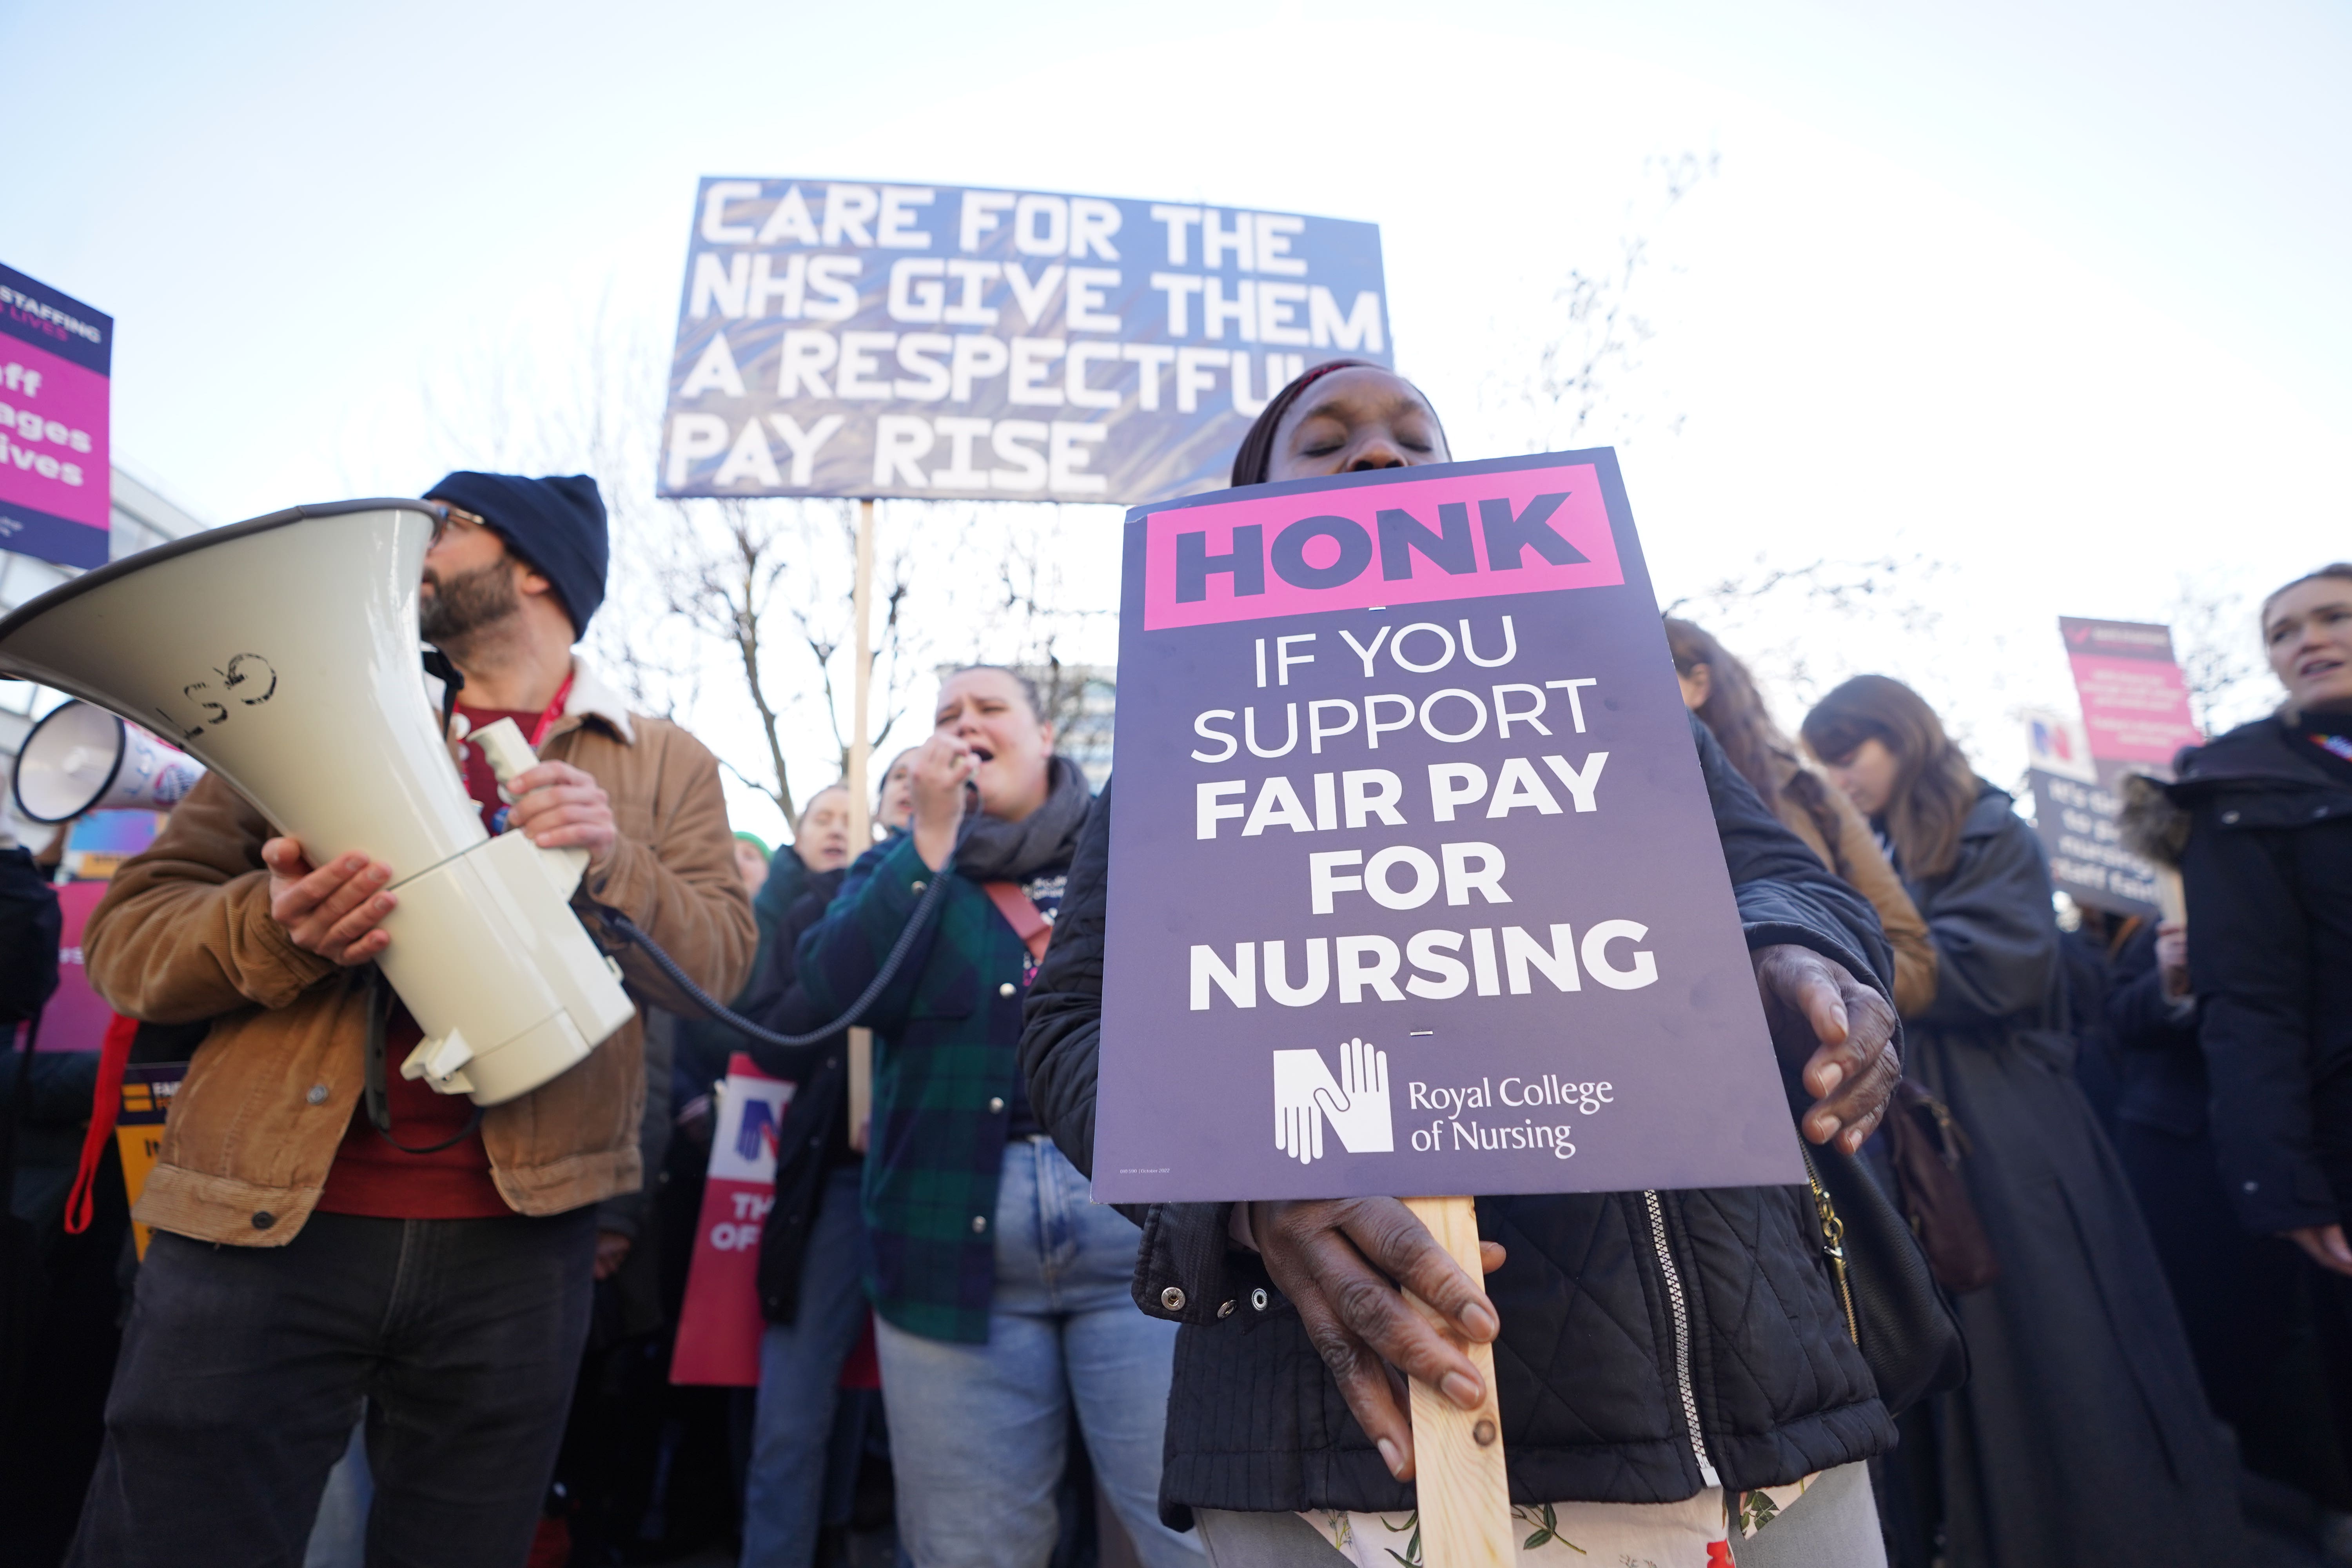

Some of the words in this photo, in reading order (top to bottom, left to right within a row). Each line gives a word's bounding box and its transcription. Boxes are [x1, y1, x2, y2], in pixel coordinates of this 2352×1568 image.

[701, 180, 936, 250] CARE
[959, 189, 1122, 262] FOR
[1151, 205, 1308, 277] THE
[0, 285, 101, 344] STAFFING
[688, 252, 862, 321] NHS
[887, 256, 1122, 333] GIVE
[1150, 272, 1384, 353] THEM
[0, 361, 42, 398] ff
[679, 330, 748, 399] A
[665, 413, 846, 488] PAY
[872, 414, 1108, 493] RISE
[1176, 492, 1591, 603] HONK
[1256, 634, 1316, 688] IF
[1338, 615, 1517, 677] YOU
[1191, 678, 1597, 763] SUPPORT
[1197, 769, 1408, 840] FAIR
[1428, 751, 1609, 822] PAY
[1309, 842, 1513, 915] FOR
[1190, 919, 1658, 1011] NURSING
[1409, 1077, 1492, 1120] Royal
[1500, 1074, 1613, 1115] College
[1412, 1120, 1444, 1151] of
[1452, 1119, 1576, 1159] Nursing
